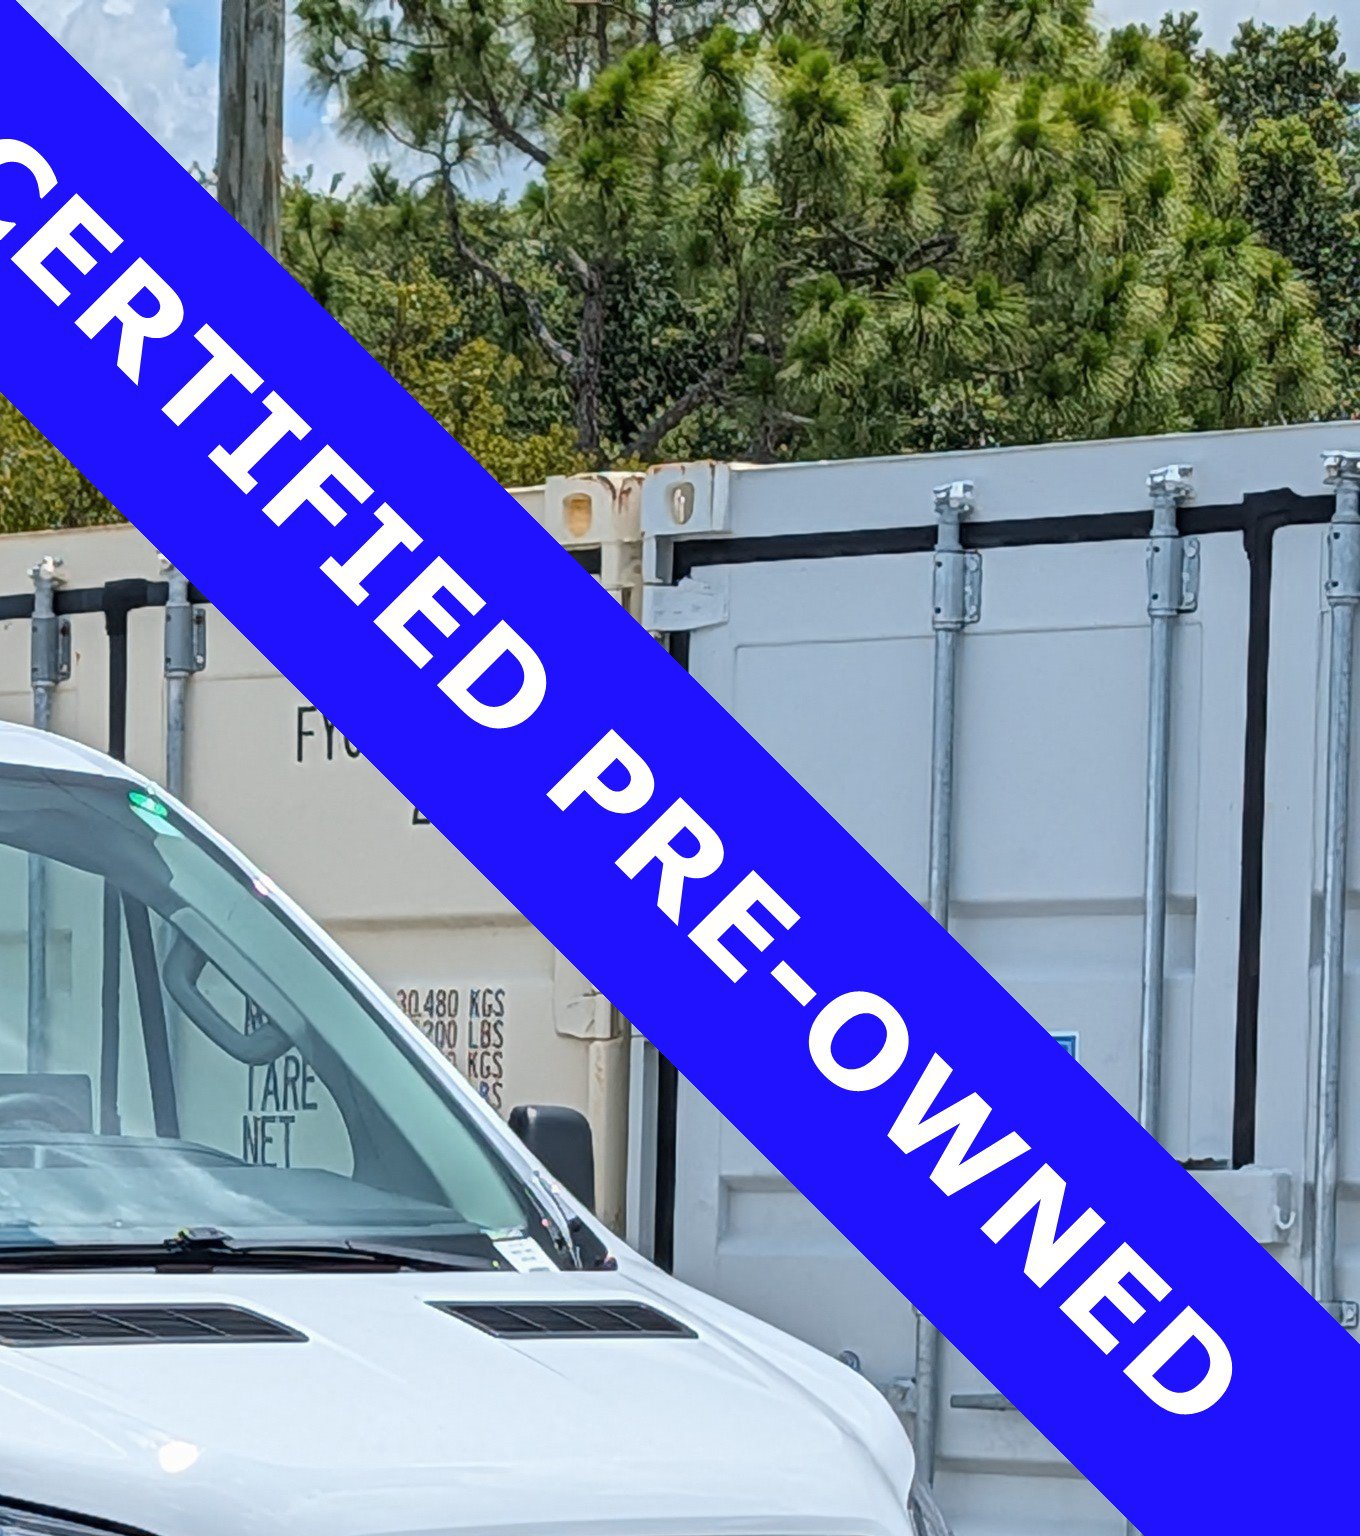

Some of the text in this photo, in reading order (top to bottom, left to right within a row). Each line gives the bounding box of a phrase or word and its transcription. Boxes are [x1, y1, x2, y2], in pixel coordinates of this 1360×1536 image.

[469, 988, 505, 1018] KGS
[468, 1019, 504, 1049] LBS
[468, 1051, 503, 1079] KGS
[248, 1055, 317, 1111] TARE
[243, 1115, 295, 1168] NET
